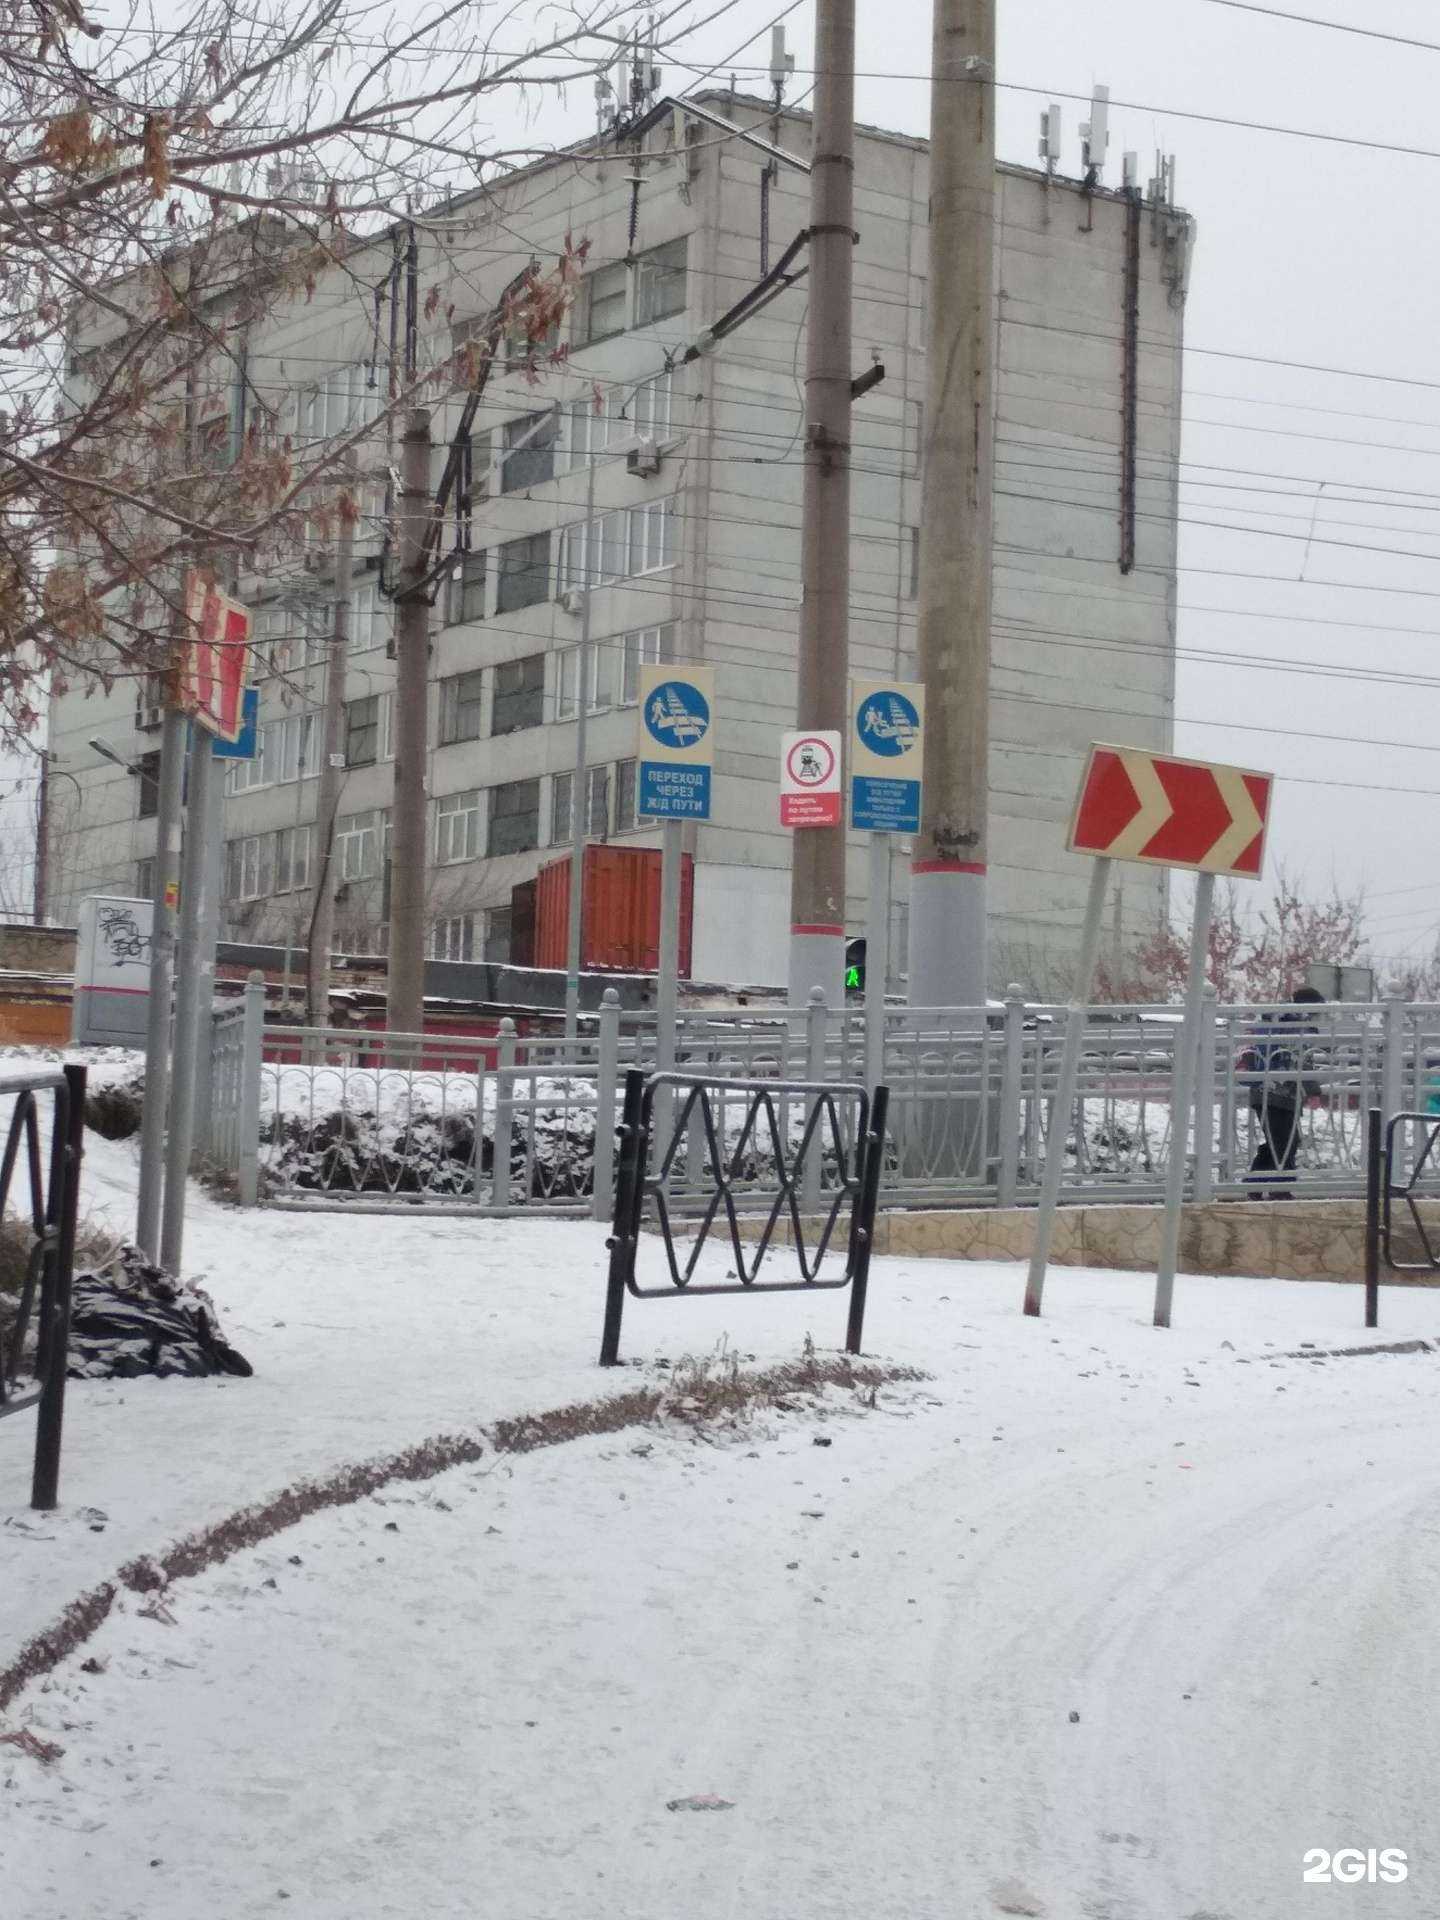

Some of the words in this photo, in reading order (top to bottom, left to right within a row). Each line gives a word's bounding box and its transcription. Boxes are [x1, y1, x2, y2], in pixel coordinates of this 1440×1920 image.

[647, 770, 704, 786] ПЕРЕХОД
[656, 784, 695, 798] ЧЕРЕЗ
[671, 798, 703, 812] ПУТИ
